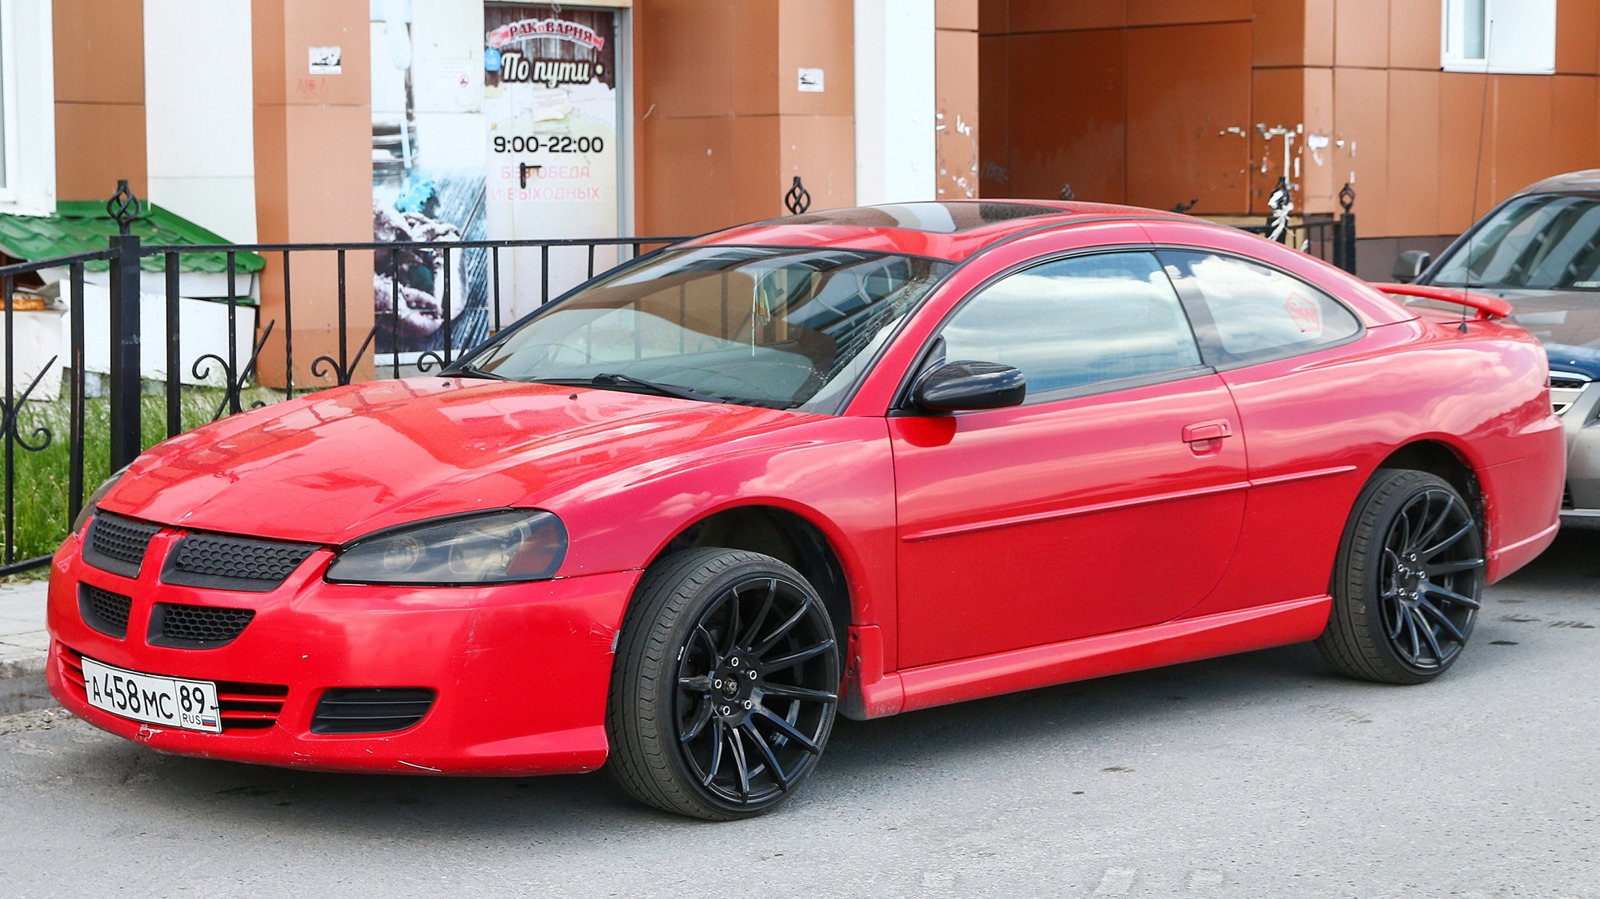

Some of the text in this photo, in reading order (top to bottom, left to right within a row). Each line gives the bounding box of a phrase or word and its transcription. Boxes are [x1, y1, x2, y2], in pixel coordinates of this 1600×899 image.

[501, 52, 530, 81] По
[533, 60, 590, 89] пути
[494, 136, 604, 153] 9:00-22:00
[536, 165, 591, 180] ОБЕДА
[491, 187, 600, 201] И ВЫХОДНЫХ
[180, 685, 206, 714] 89
[182, 713, 202, 725] RUS
